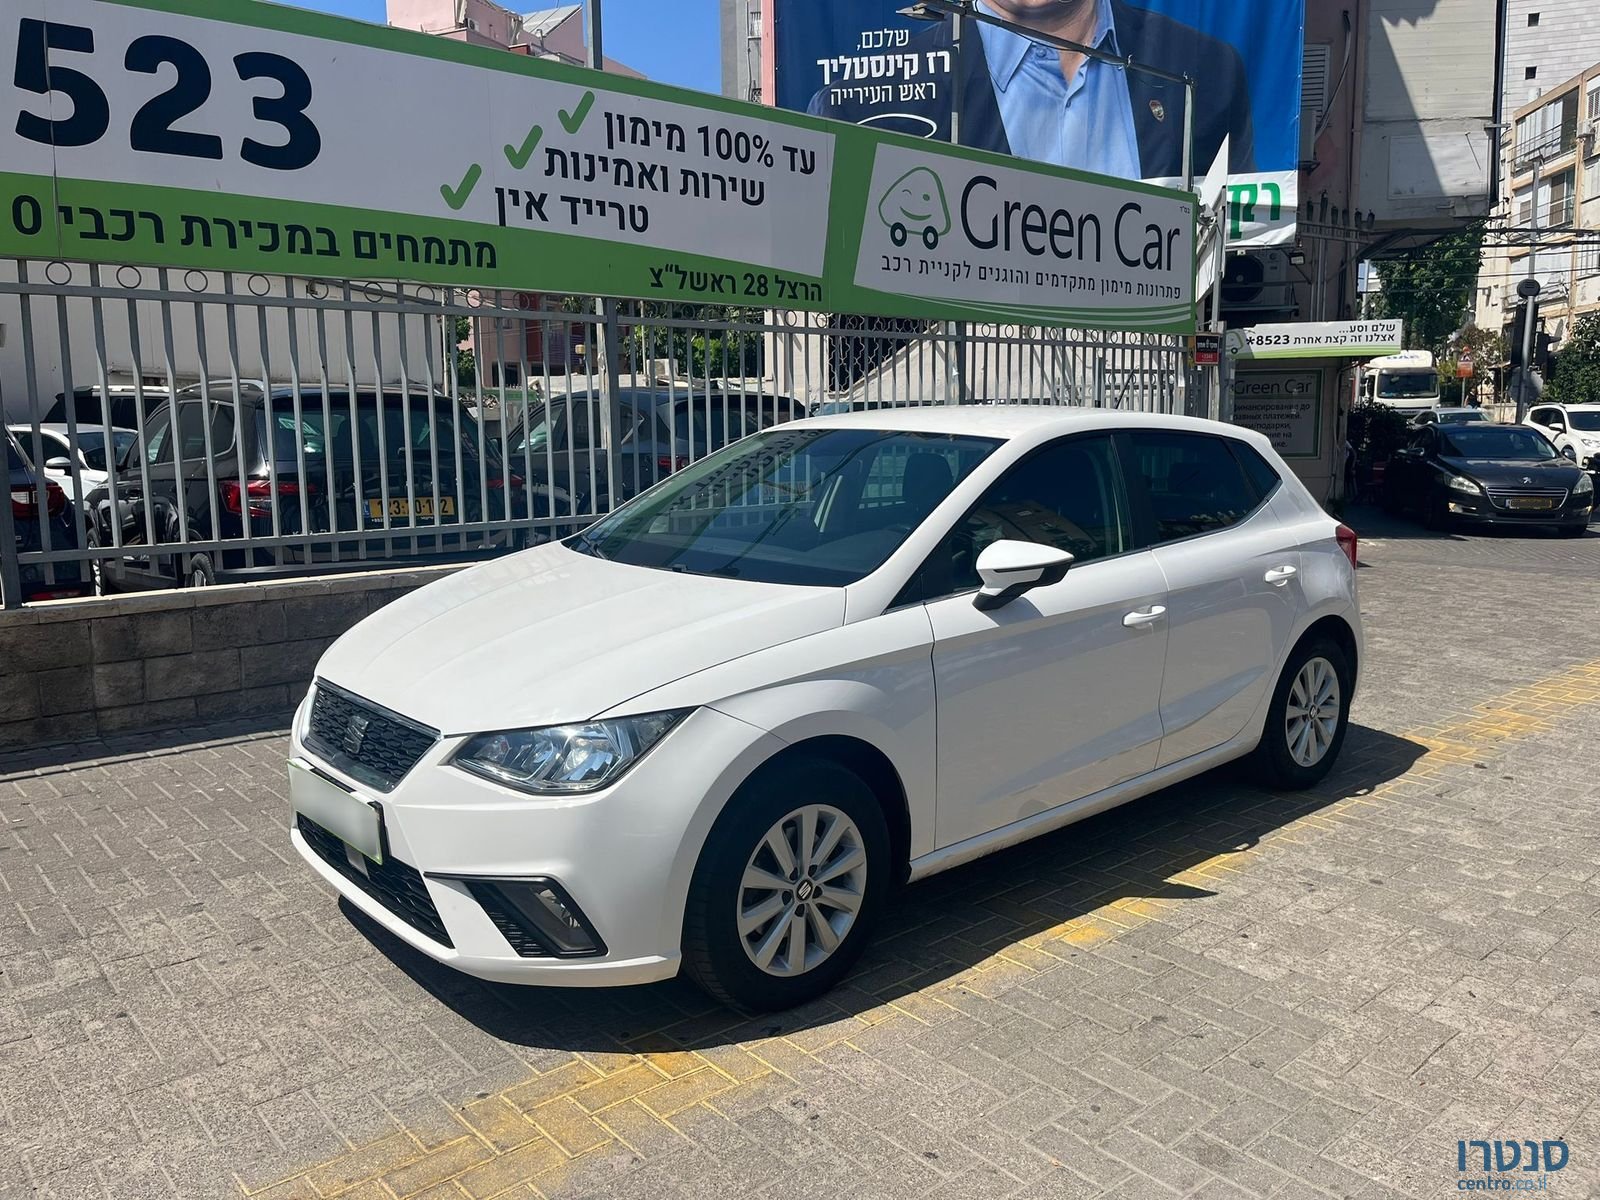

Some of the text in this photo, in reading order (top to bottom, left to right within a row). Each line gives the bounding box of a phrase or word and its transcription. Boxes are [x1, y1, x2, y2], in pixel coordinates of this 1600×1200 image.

[856, 28, 909, 51] שלכם,
[816, 50, 951, 85] רז קינסטליך
[13, 17, 322, 171] 523
[830, 82, 936, 106] ראש העירייה
[604, 111, 816, 175] עד 100% מימון
[544, 147, 765, 206] שירות ואמינות
[494, 187, 649, 233] טרייד אין
[12, 194, 498, 269] מתמחים במכירת רכבי 0
[961, 175, 1181, 272] Green Car
[743, 273, 769, 297] 28
[774, 273, 823, 302] הרצל
[881, 254, 1181, 300] פתרונות מימון מתקדמים והוגנים לקניית רכב
[1293, 335, 1322, 345] אחרת
[1325, 334, 1347, 345] קצת
[1350, 334, 1362, 343] זה
[1365, 332, 1395, 343] אצלנו
[1371, 322, 1396, 333] שלם
[1235, 379, 1312, 395] Green Car
